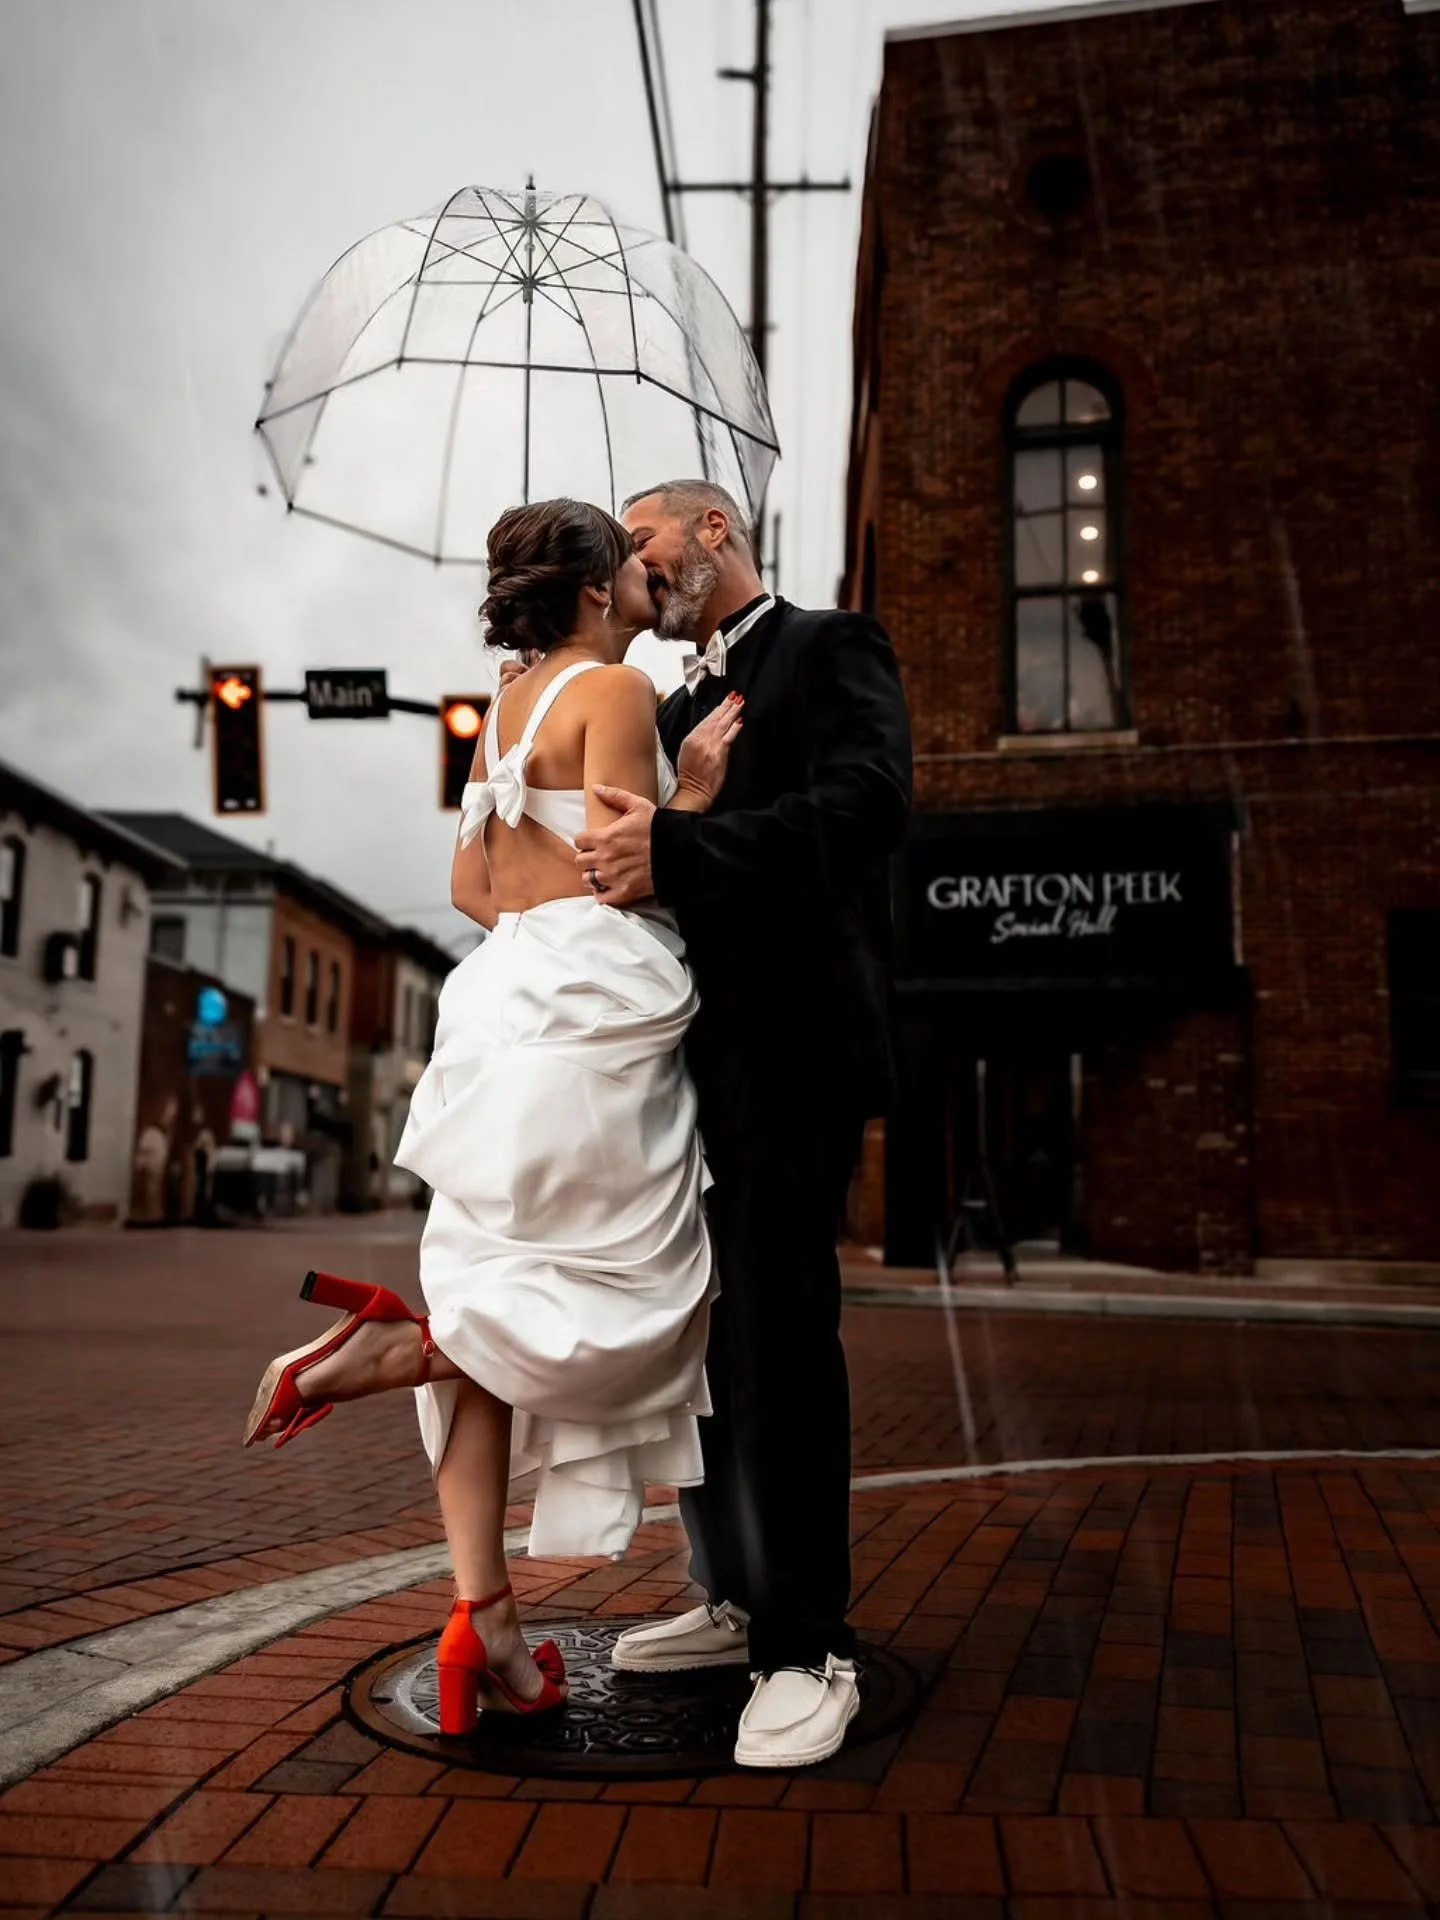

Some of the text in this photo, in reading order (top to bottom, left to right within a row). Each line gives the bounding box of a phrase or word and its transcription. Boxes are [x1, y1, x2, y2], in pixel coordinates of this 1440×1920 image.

[308, 680, 373, 707] Main
[927, 870, 1182, 909] GRAFTON PEEK
[1066, 904, 1118, 939] Hall
